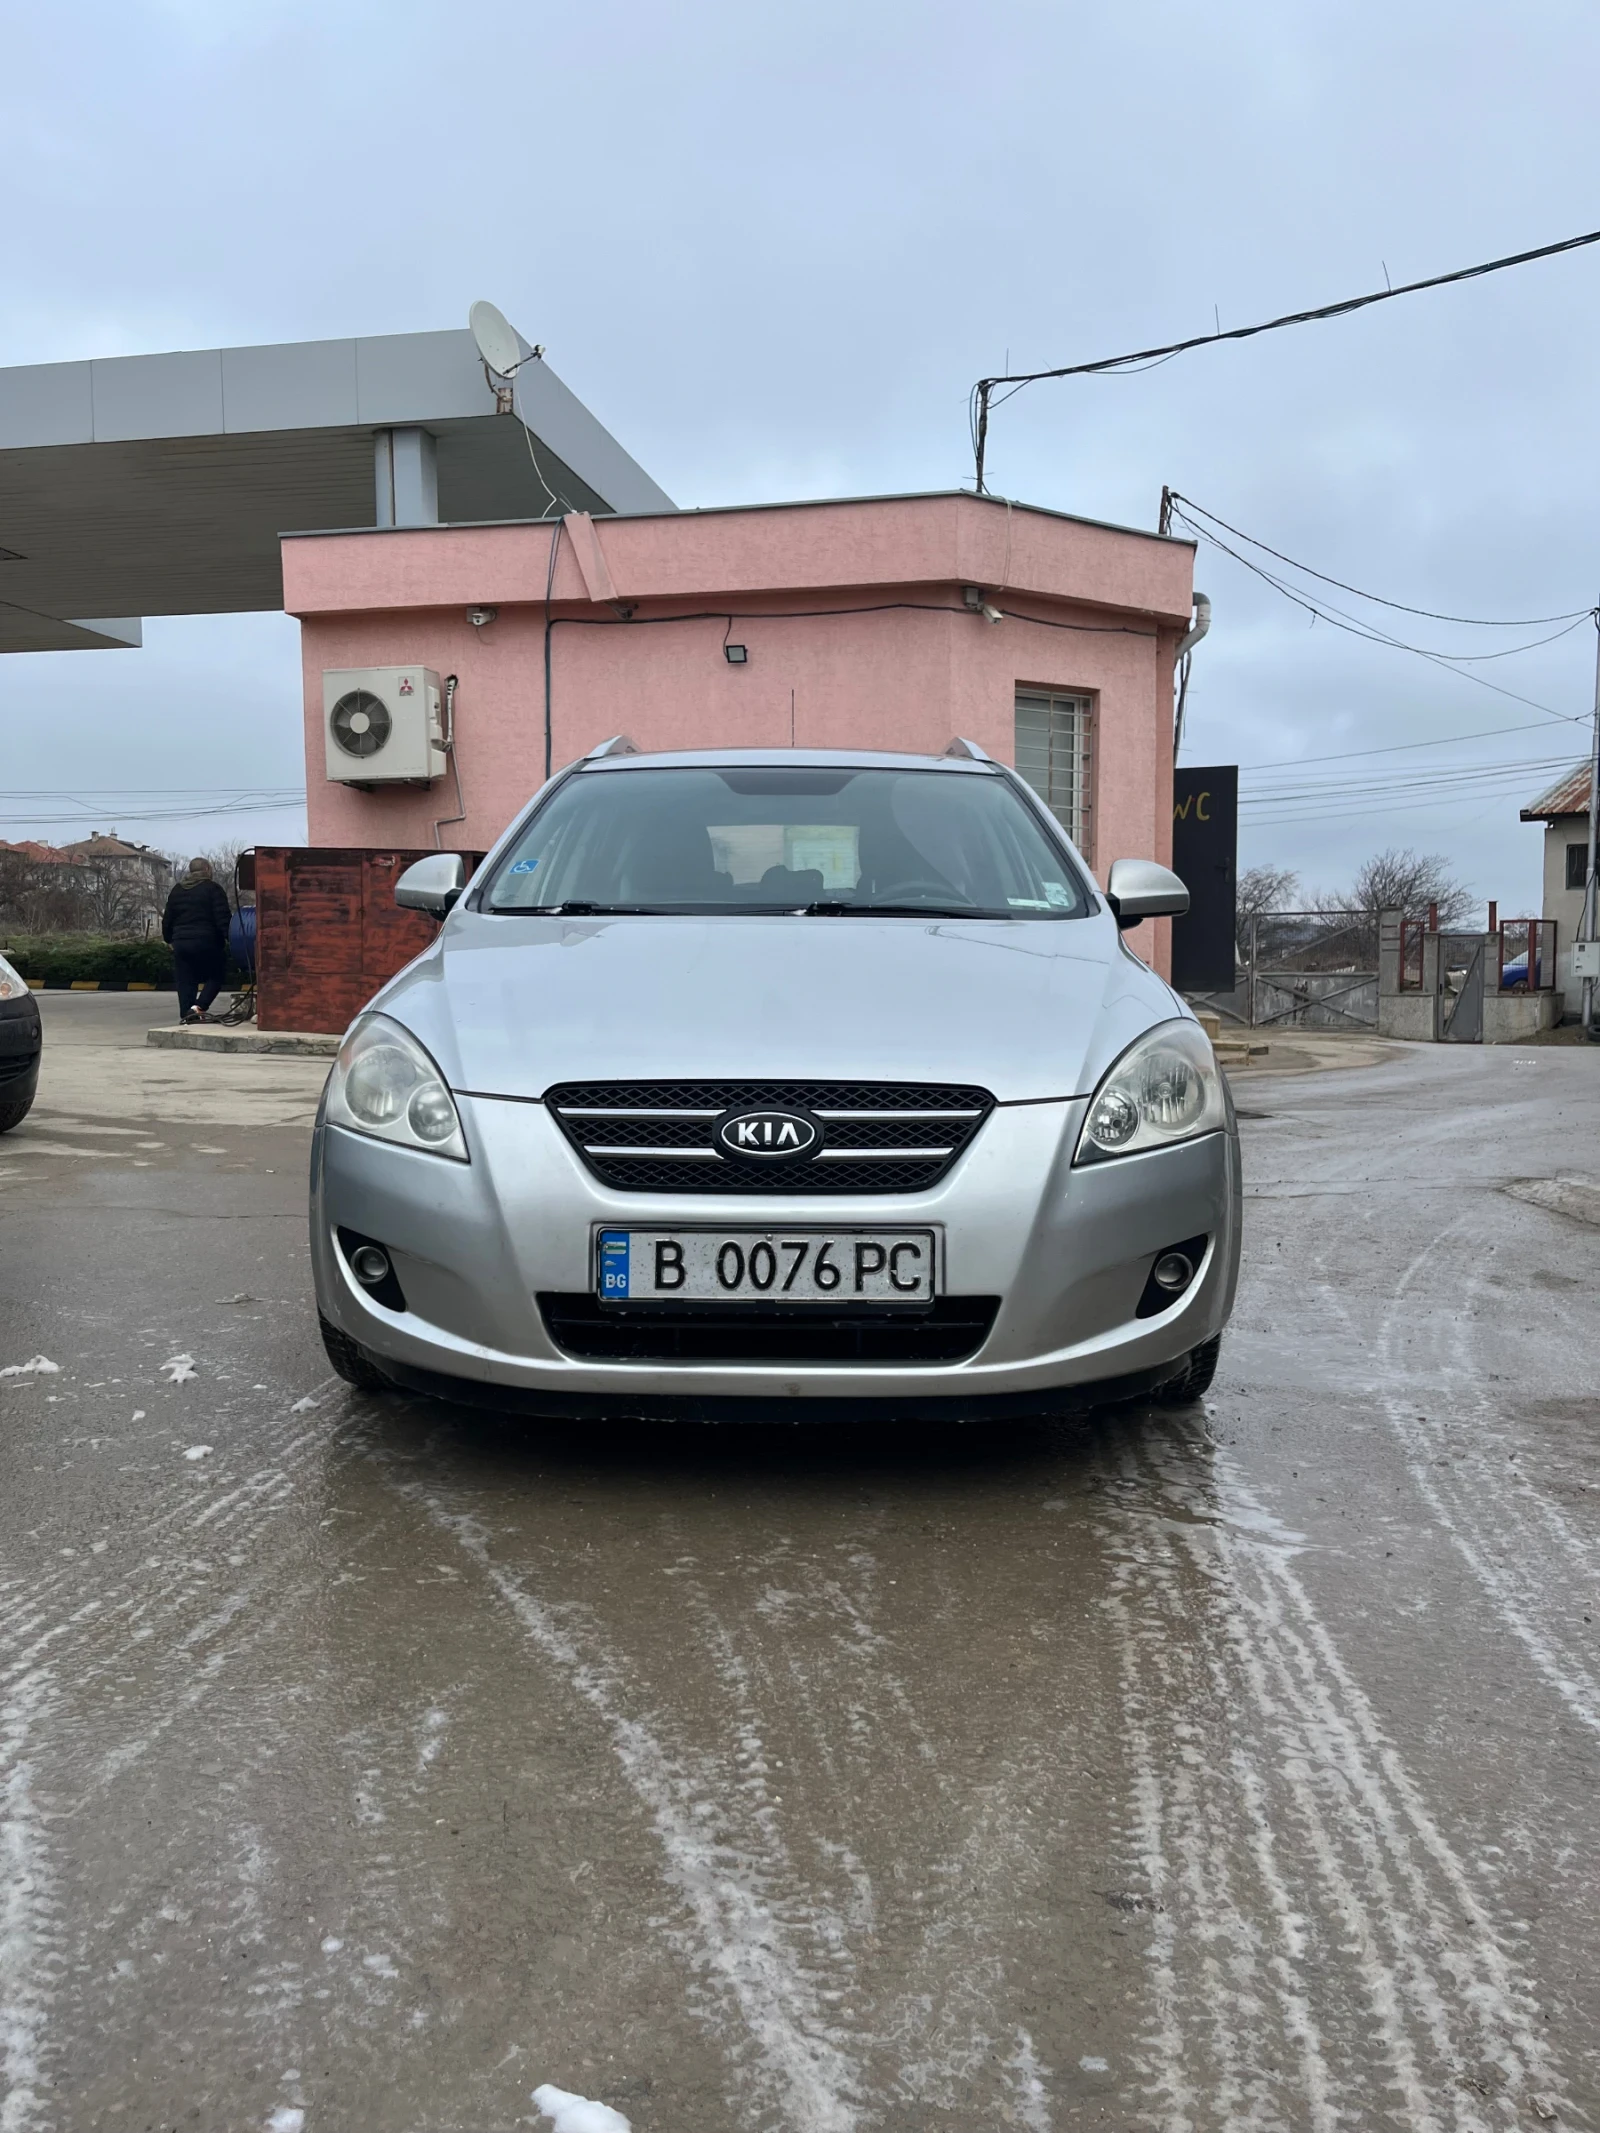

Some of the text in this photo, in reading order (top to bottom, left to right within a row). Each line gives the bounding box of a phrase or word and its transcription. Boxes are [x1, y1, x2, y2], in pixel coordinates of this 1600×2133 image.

[737, 1121, 800, 1146] KIA
[654, 1239, 686, 1291] B
[716, 1239, 841, 1292] 0076
[605, 1273, 627, 1289] BG
